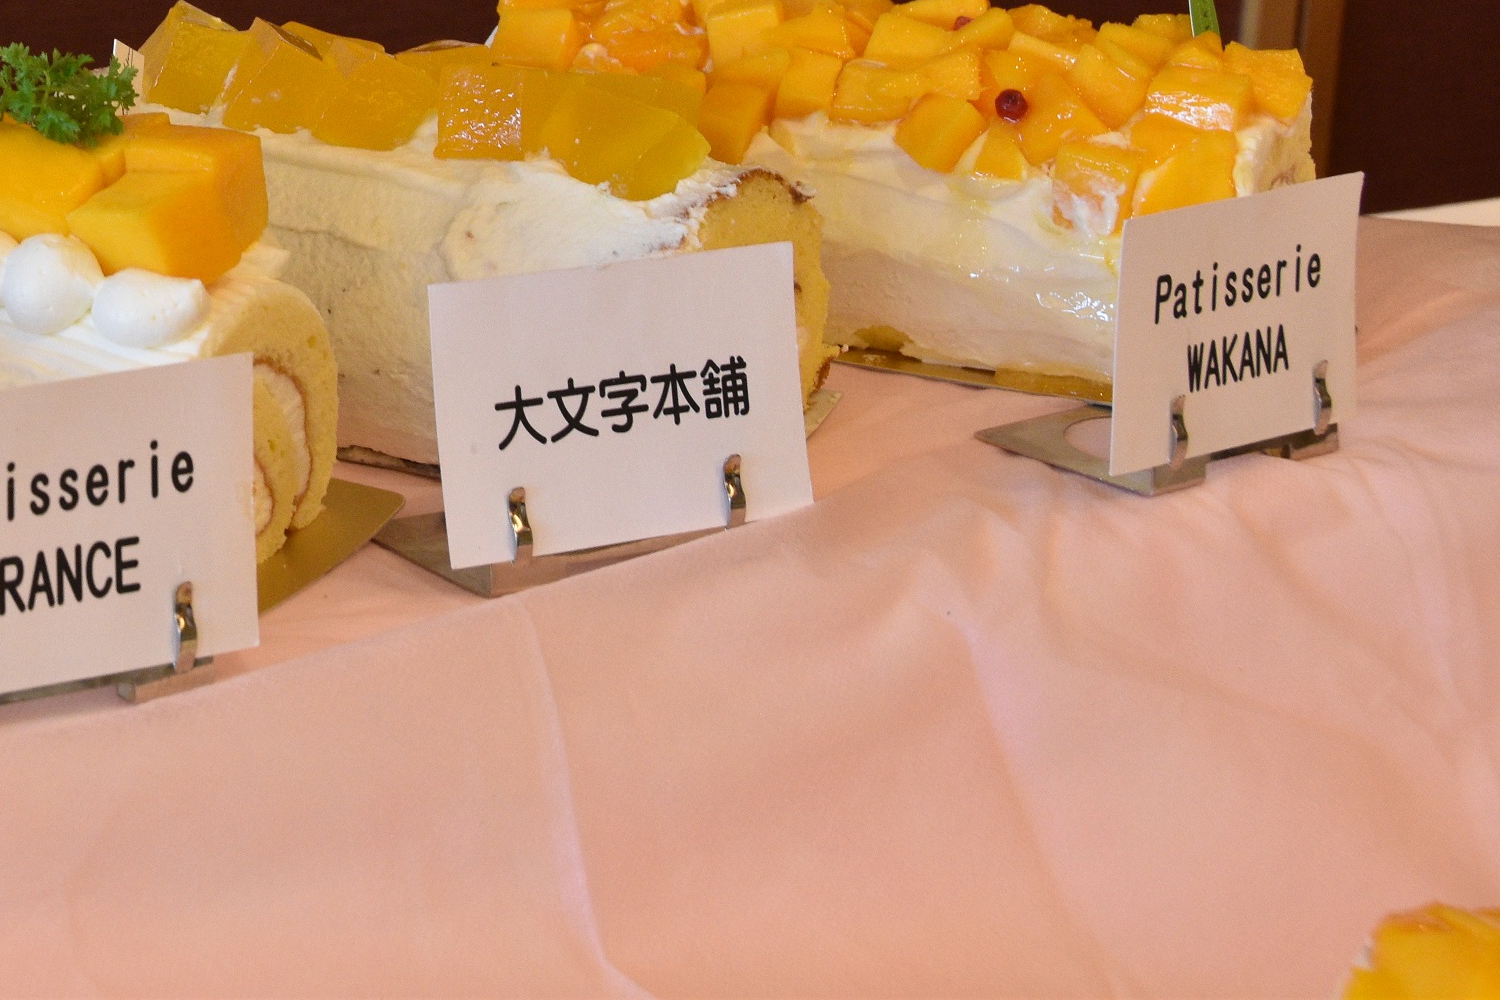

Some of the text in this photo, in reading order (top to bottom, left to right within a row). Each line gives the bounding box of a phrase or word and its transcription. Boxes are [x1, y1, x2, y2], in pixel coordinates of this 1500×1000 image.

[1155, 243, 1322, 325] Patisserie
[1187, 323, 1290, 393] WAKANA
[494, 355, 751, 451] 大文字本舗
